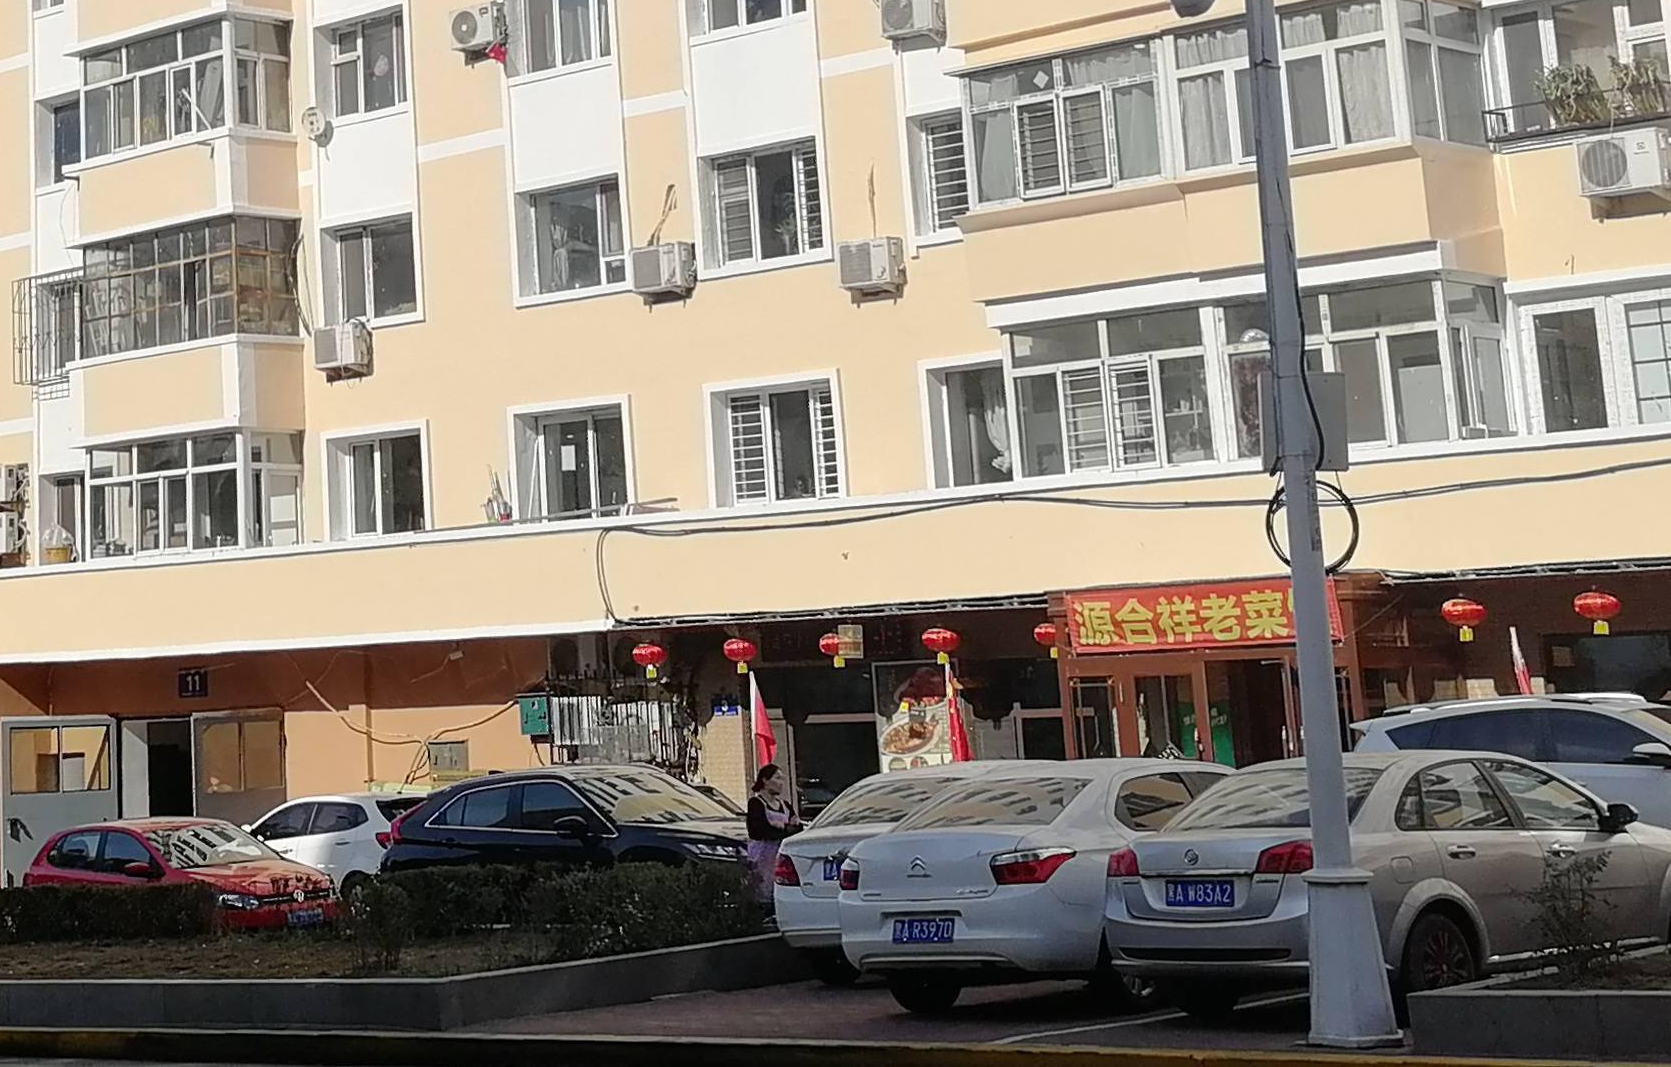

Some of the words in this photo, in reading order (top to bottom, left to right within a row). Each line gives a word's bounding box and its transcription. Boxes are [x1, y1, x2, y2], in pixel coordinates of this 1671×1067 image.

[1075, 589, 1294, 645] 源合祥老菜
[186, 675, 200, 691] 11
